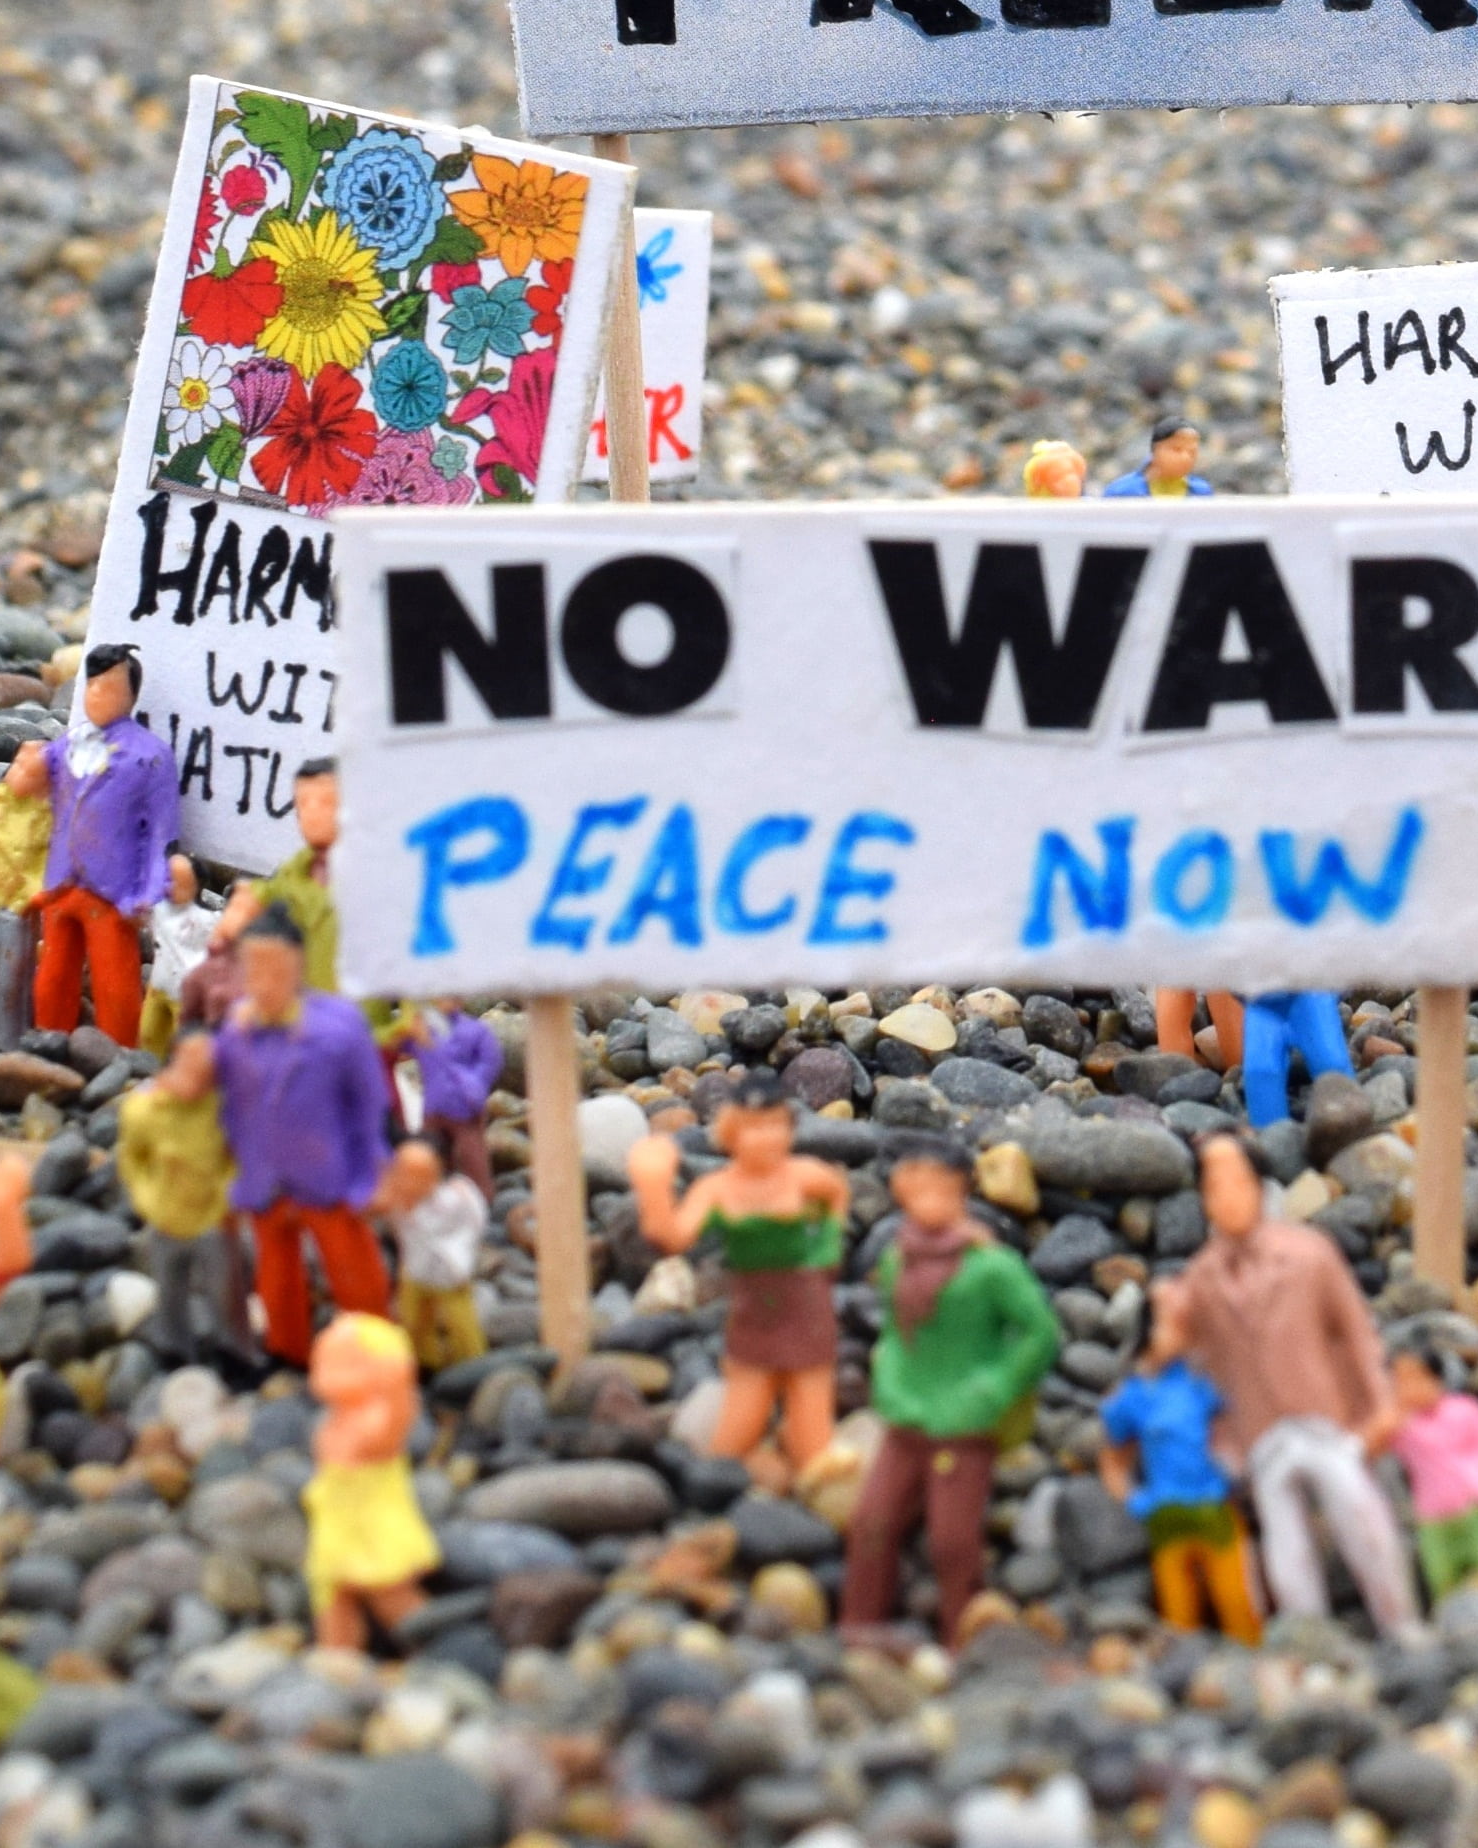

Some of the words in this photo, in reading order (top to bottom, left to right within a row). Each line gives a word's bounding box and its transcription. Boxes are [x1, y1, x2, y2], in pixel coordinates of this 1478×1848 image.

[130, 492, 340, 632] HARM
[208, 651, 339, 732] WIT
[384, 552, 732, 725] NO
[137, 712, 293, 818] ATU
[405, 795, 915, 952] PEACE
[1022, 805, 1424, 949] NOW
